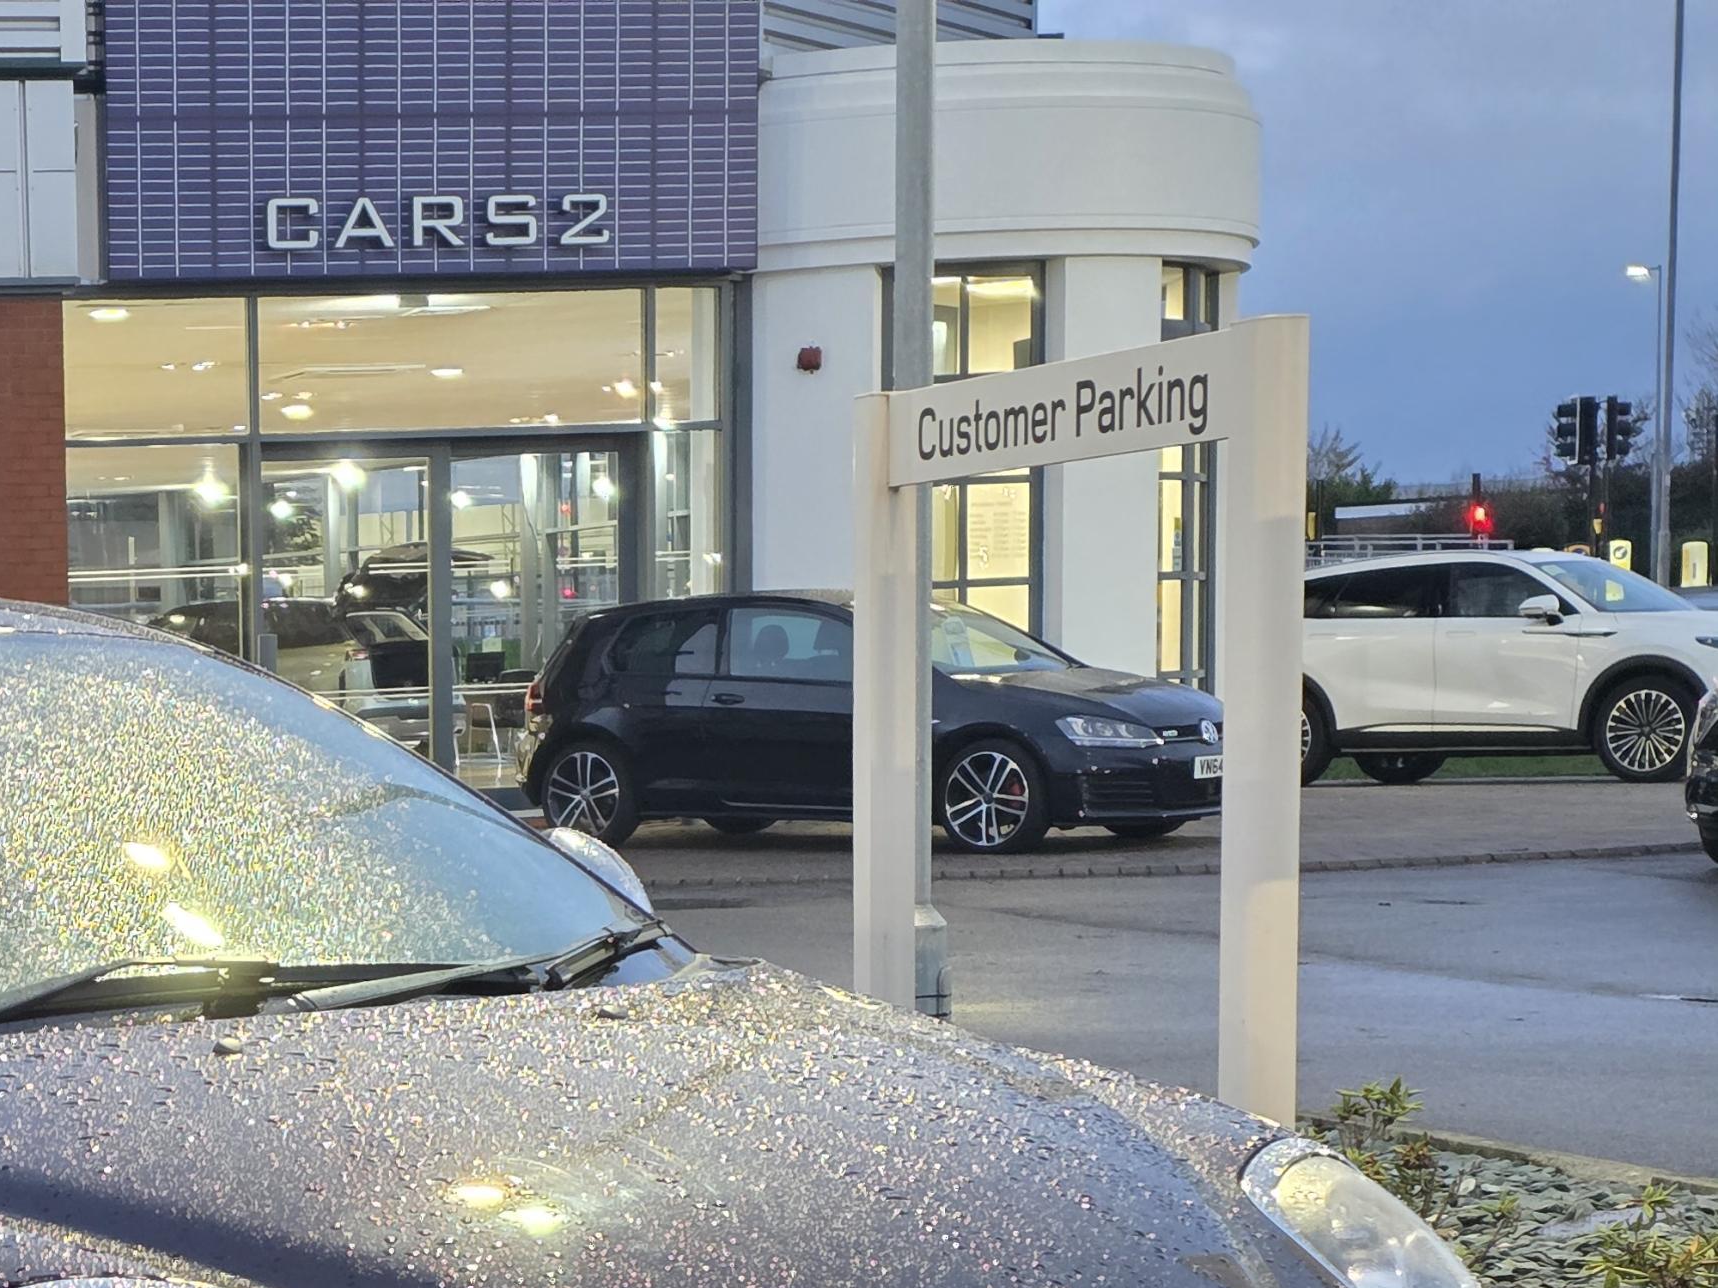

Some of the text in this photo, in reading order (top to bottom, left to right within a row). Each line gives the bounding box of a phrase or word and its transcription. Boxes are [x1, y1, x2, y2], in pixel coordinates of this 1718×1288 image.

[267, 194, 610, 249] CARS2
[917, 365, 1209, 460] Customer Parking
